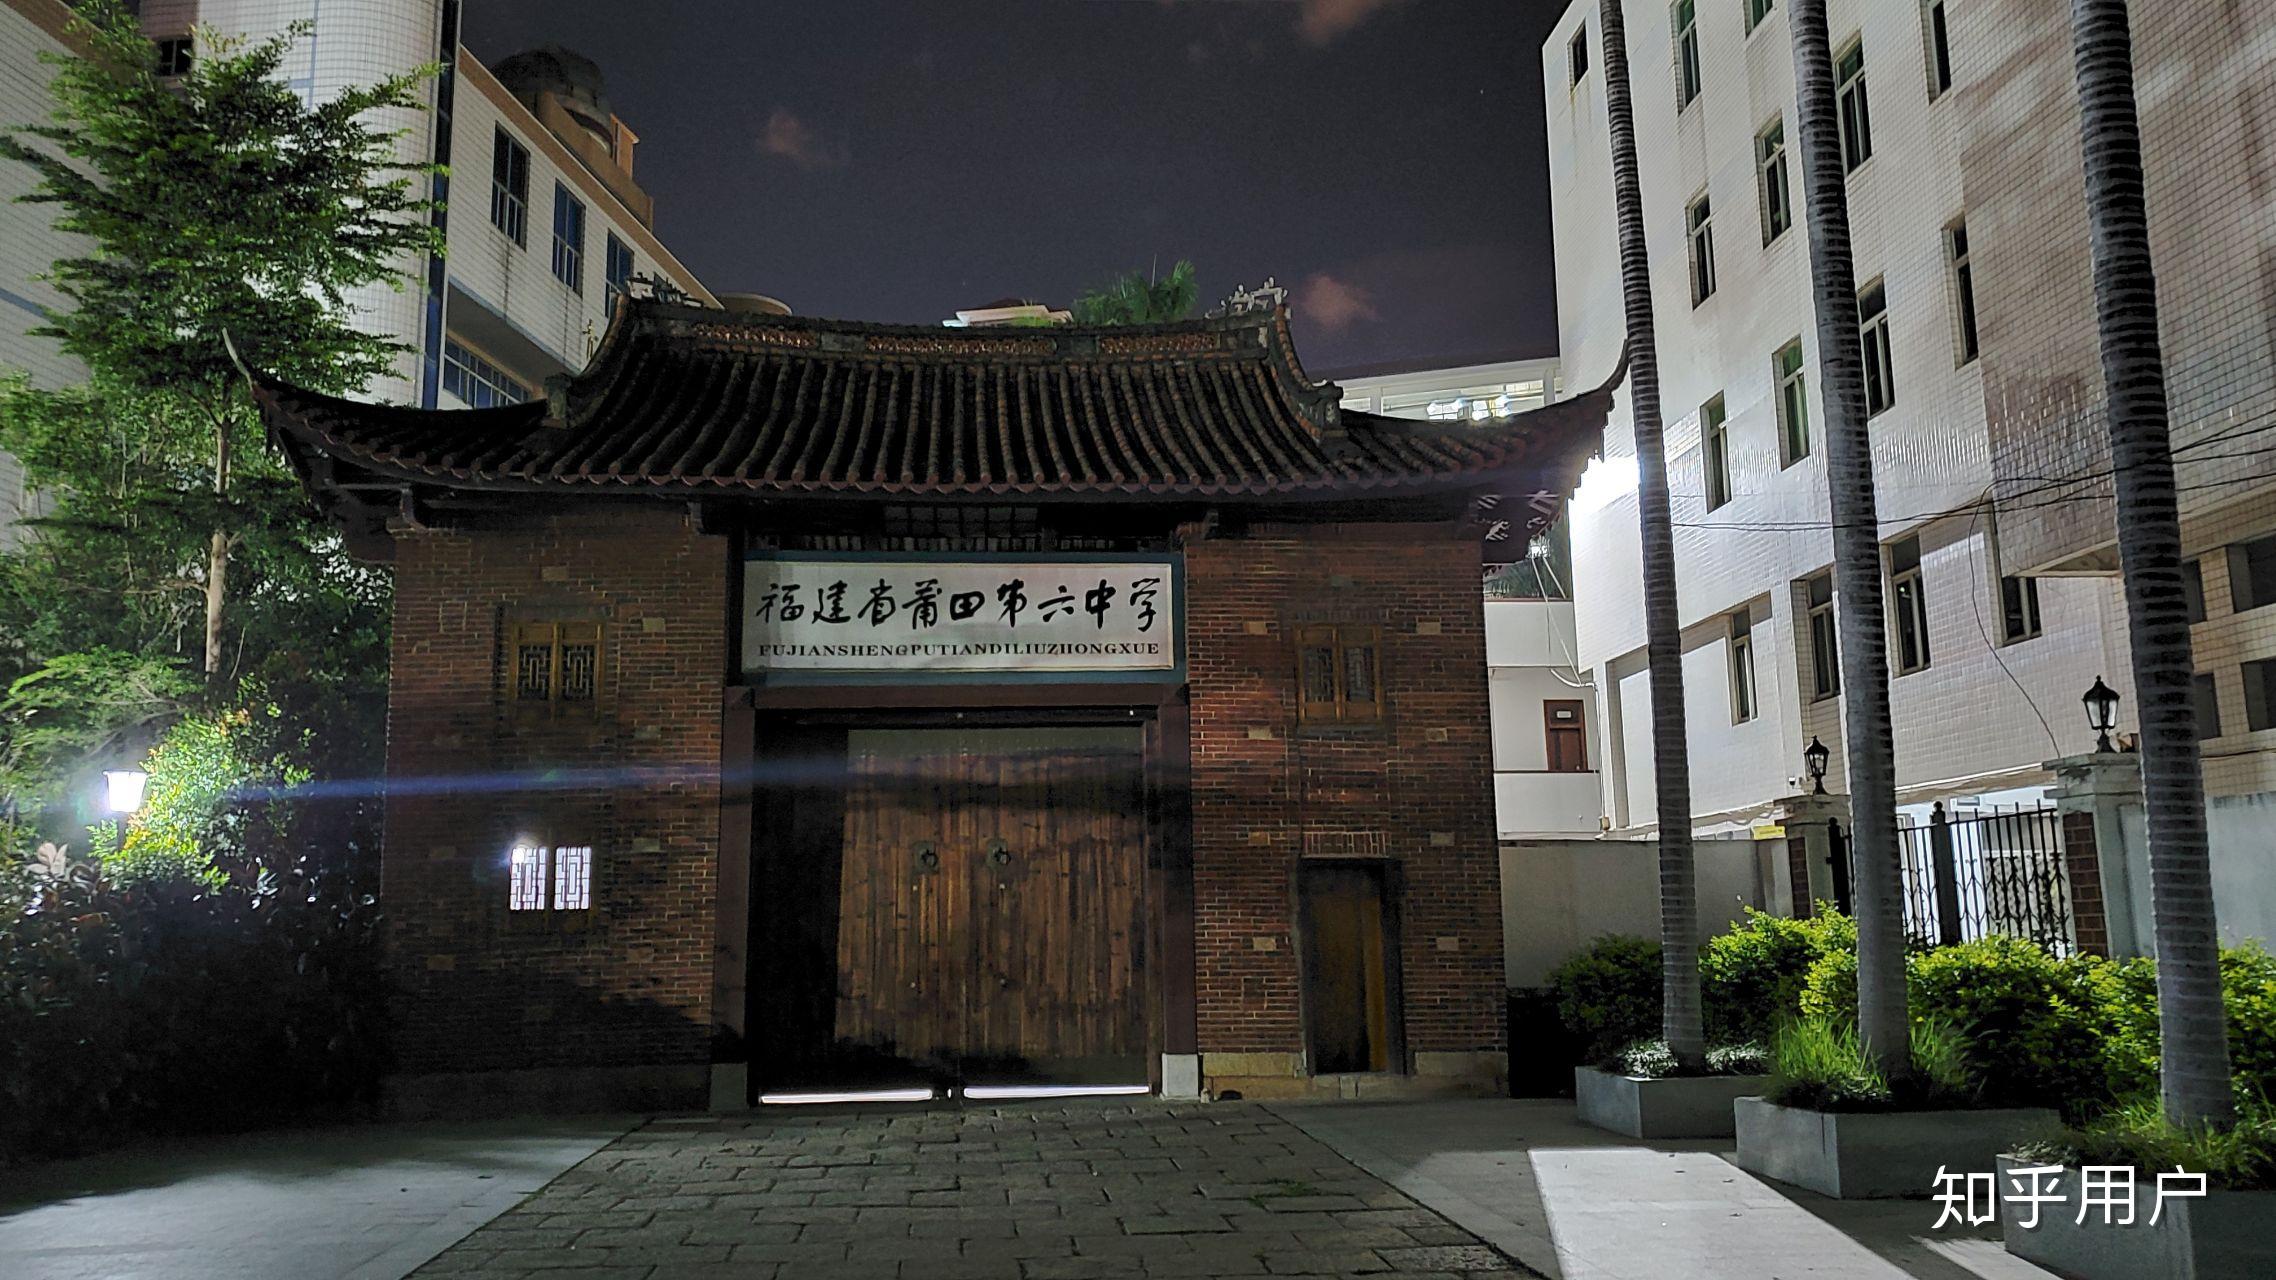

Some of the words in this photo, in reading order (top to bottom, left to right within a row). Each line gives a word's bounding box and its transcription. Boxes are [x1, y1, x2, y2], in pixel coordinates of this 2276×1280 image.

[756, 577, 1161, 632] 福建省莆田第六中学
[759, 643, 1159, 657] FUJIANSHENGPUTIANDILIUZHONGXUE
